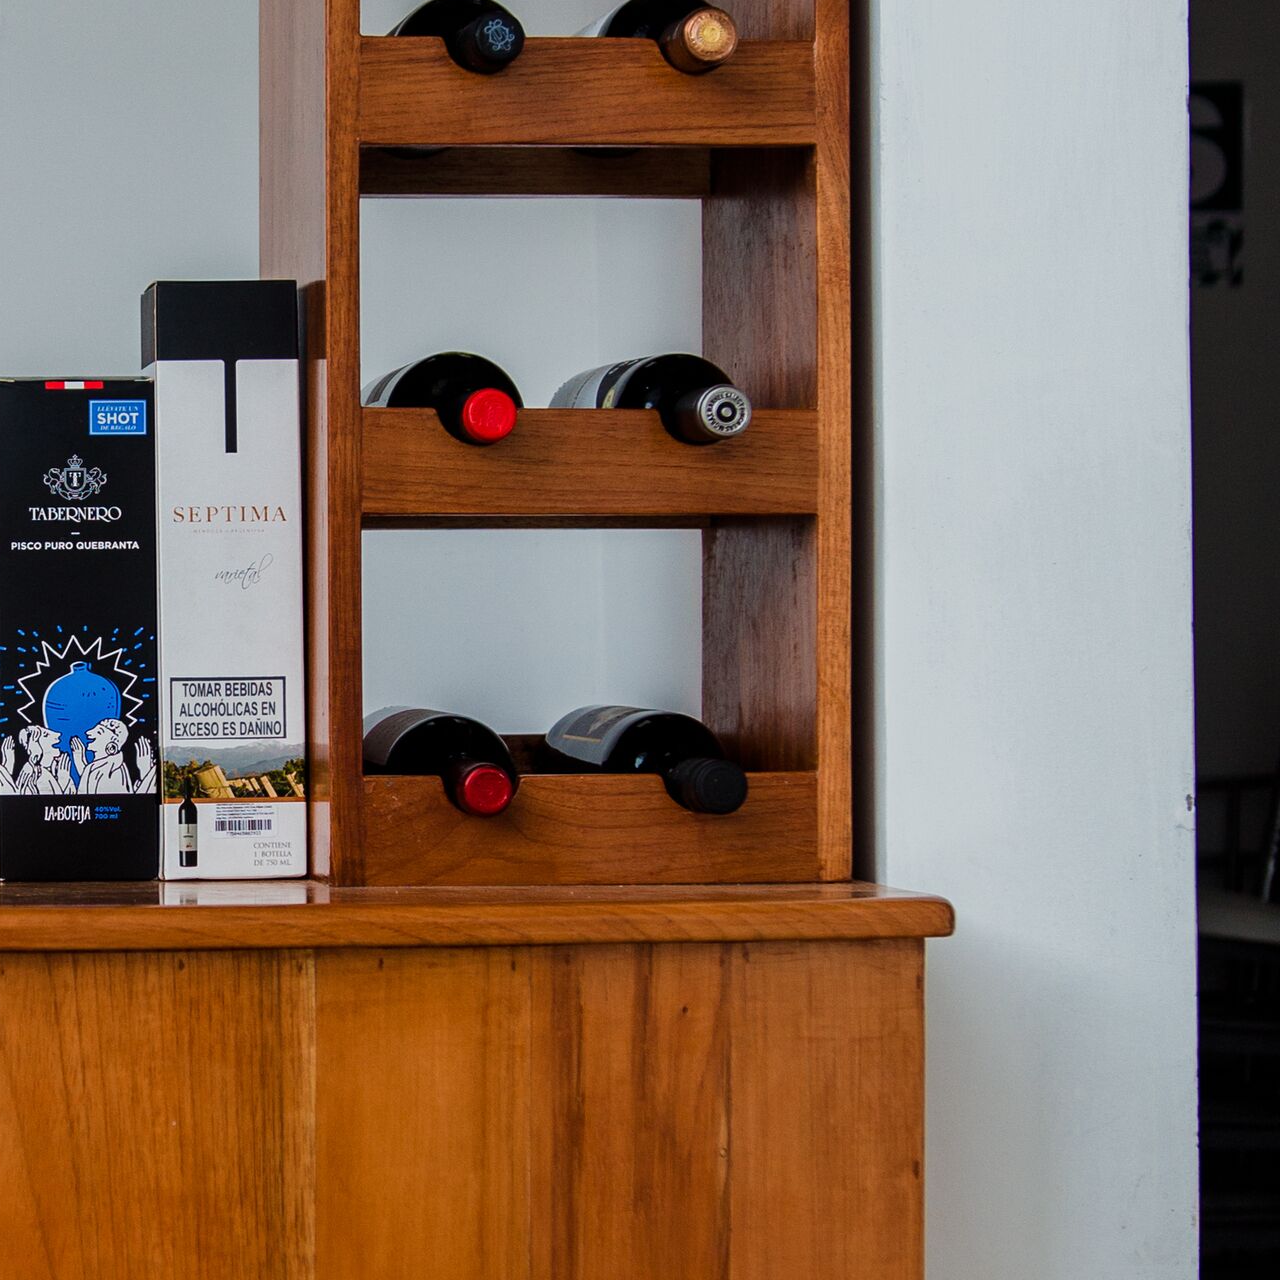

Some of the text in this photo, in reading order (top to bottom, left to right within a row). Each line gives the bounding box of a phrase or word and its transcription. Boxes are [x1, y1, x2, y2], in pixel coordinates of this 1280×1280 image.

[97, 412, 139, 425] SHOT
[28, 506, 122, 523] TABERNERO
[173, 505, 288, 523] SEPTIMA
[11, 540, 140, 551] PISCO PURO QUEBRANTA
[182, 681, 273, 698] TOMAR BEBIDAS
[179, 699, 276, 717] ALCOHÓLICAS EN
[174, 718, 282, 737] EXCESO ES DAÑINO
